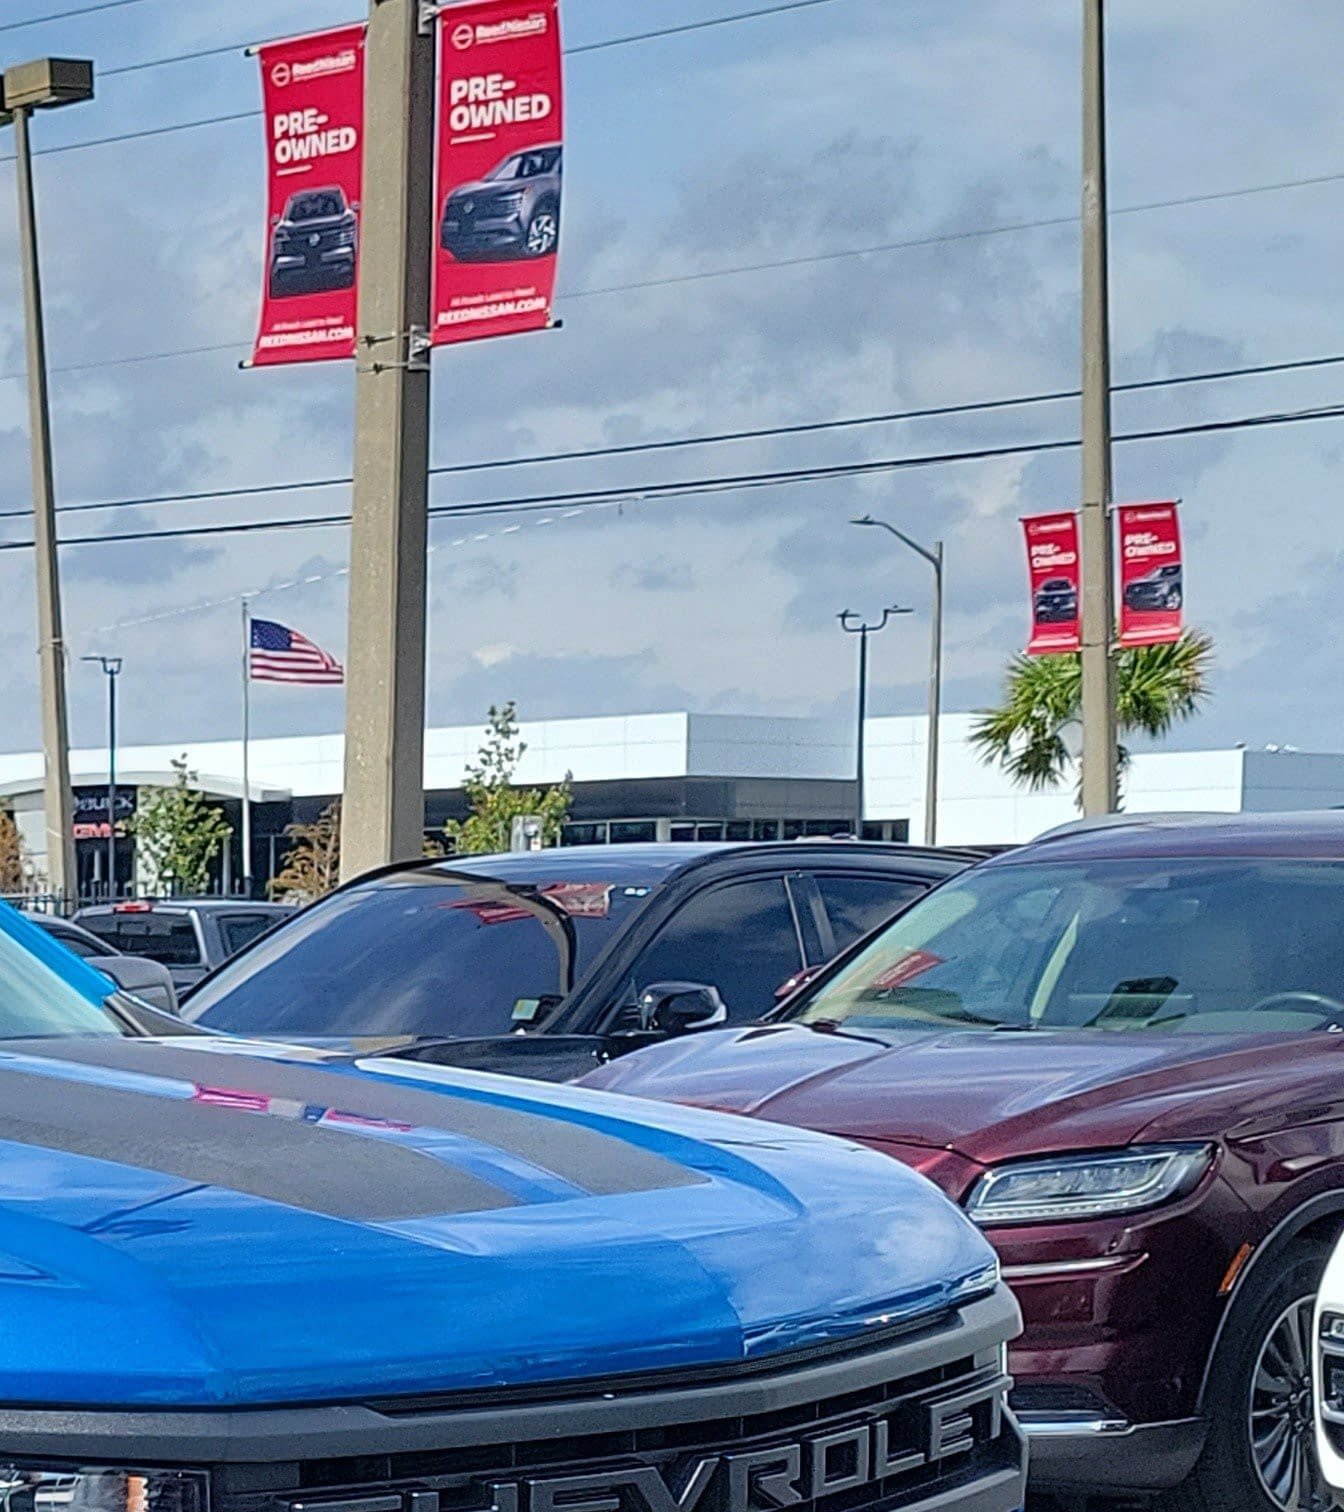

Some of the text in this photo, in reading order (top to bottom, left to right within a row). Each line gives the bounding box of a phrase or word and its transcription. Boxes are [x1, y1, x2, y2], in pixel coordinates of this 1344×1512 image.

[450, 74, 516, 104] PRE-
[274, 108, 328, 138] PRE-
[450, 95, 551, 131] OWNED
[275, 127, 356, 163] OWNED
